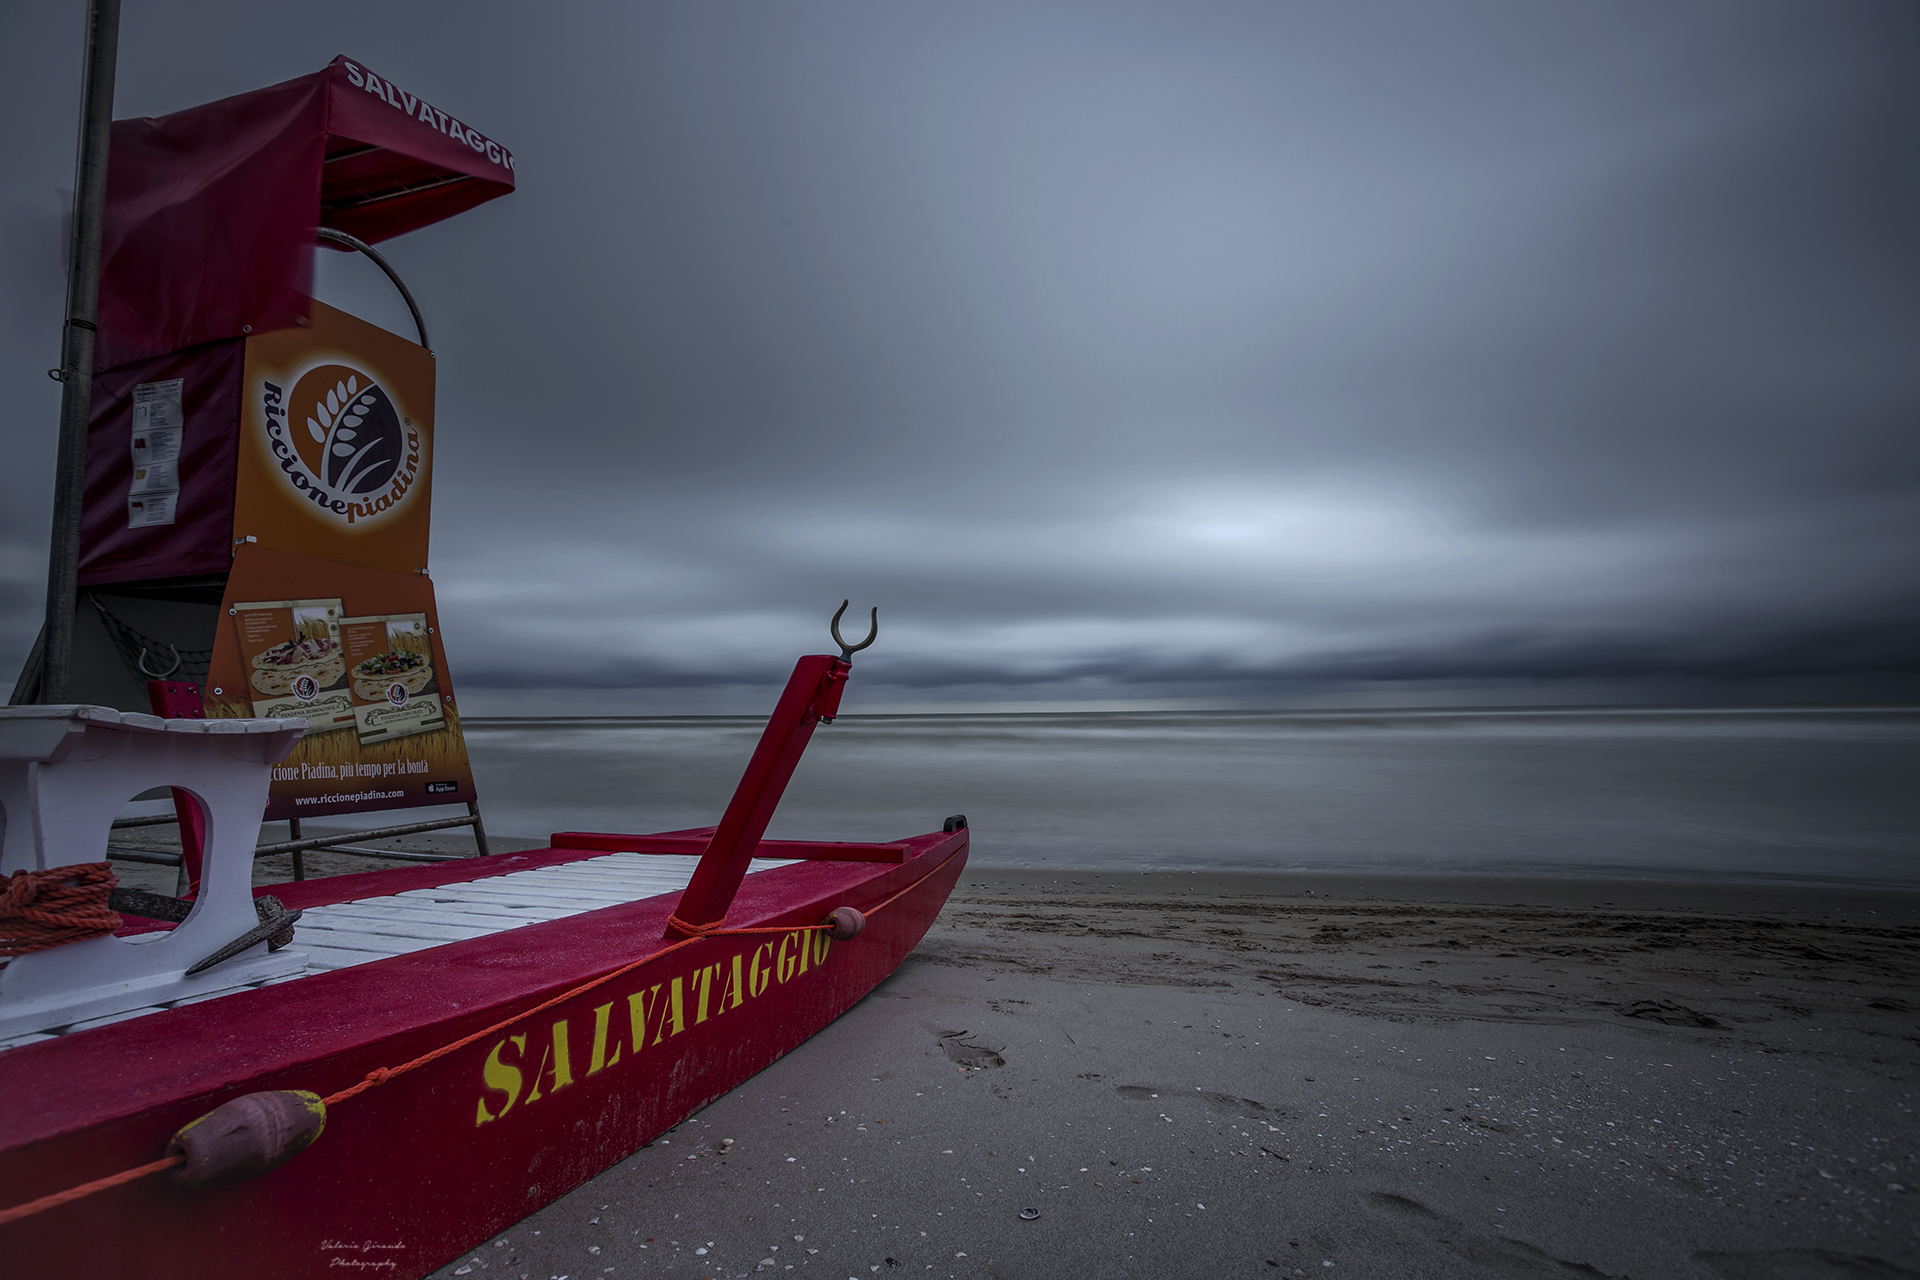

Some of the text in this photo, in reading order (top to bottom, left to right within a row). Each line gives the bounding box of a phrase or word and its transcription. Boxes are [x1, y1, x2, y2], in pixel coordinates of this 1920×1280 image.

[301, 762, 338, 780] Piadina,
[340, 761, 354, 780] più
[356, 762, 381, 778] tempo
[383, 762, 397, 778] per
[398, 759, 406, 775] la
[407, 758, 429, 774] bontà
[295, 790, 404, 806] www.riccionepiadina.com
[475, 929, 832, 1128] SALVATAGGIO
